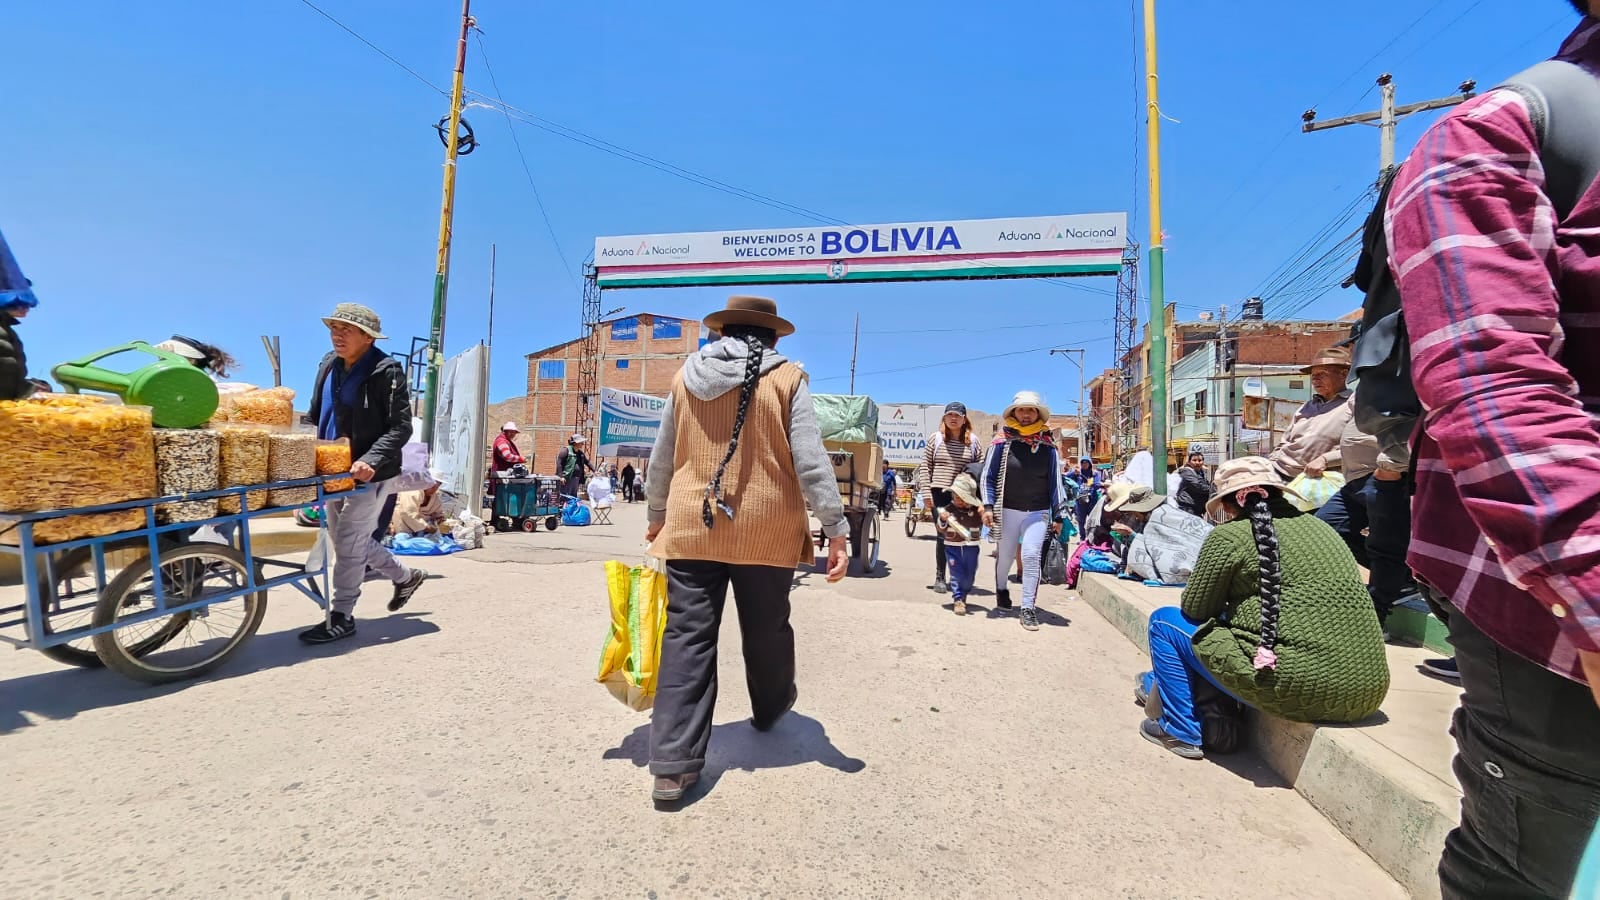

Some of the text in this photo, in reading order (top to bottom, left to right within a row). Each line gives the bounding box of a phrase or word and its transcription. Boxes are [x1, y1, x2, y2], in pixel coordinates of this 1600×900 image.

[722, 233, 816, 245] BIENVENIDOS A
[821, 226, 962, 255] BOLIVIA
[998, 226, 1117, 242] Aduana Nacional
[601, 244, 690, 257] Aduana Nacional
[734, 244, 816, 257] WELCOME TO
[880, 438, 926, 450] OLIVIA
